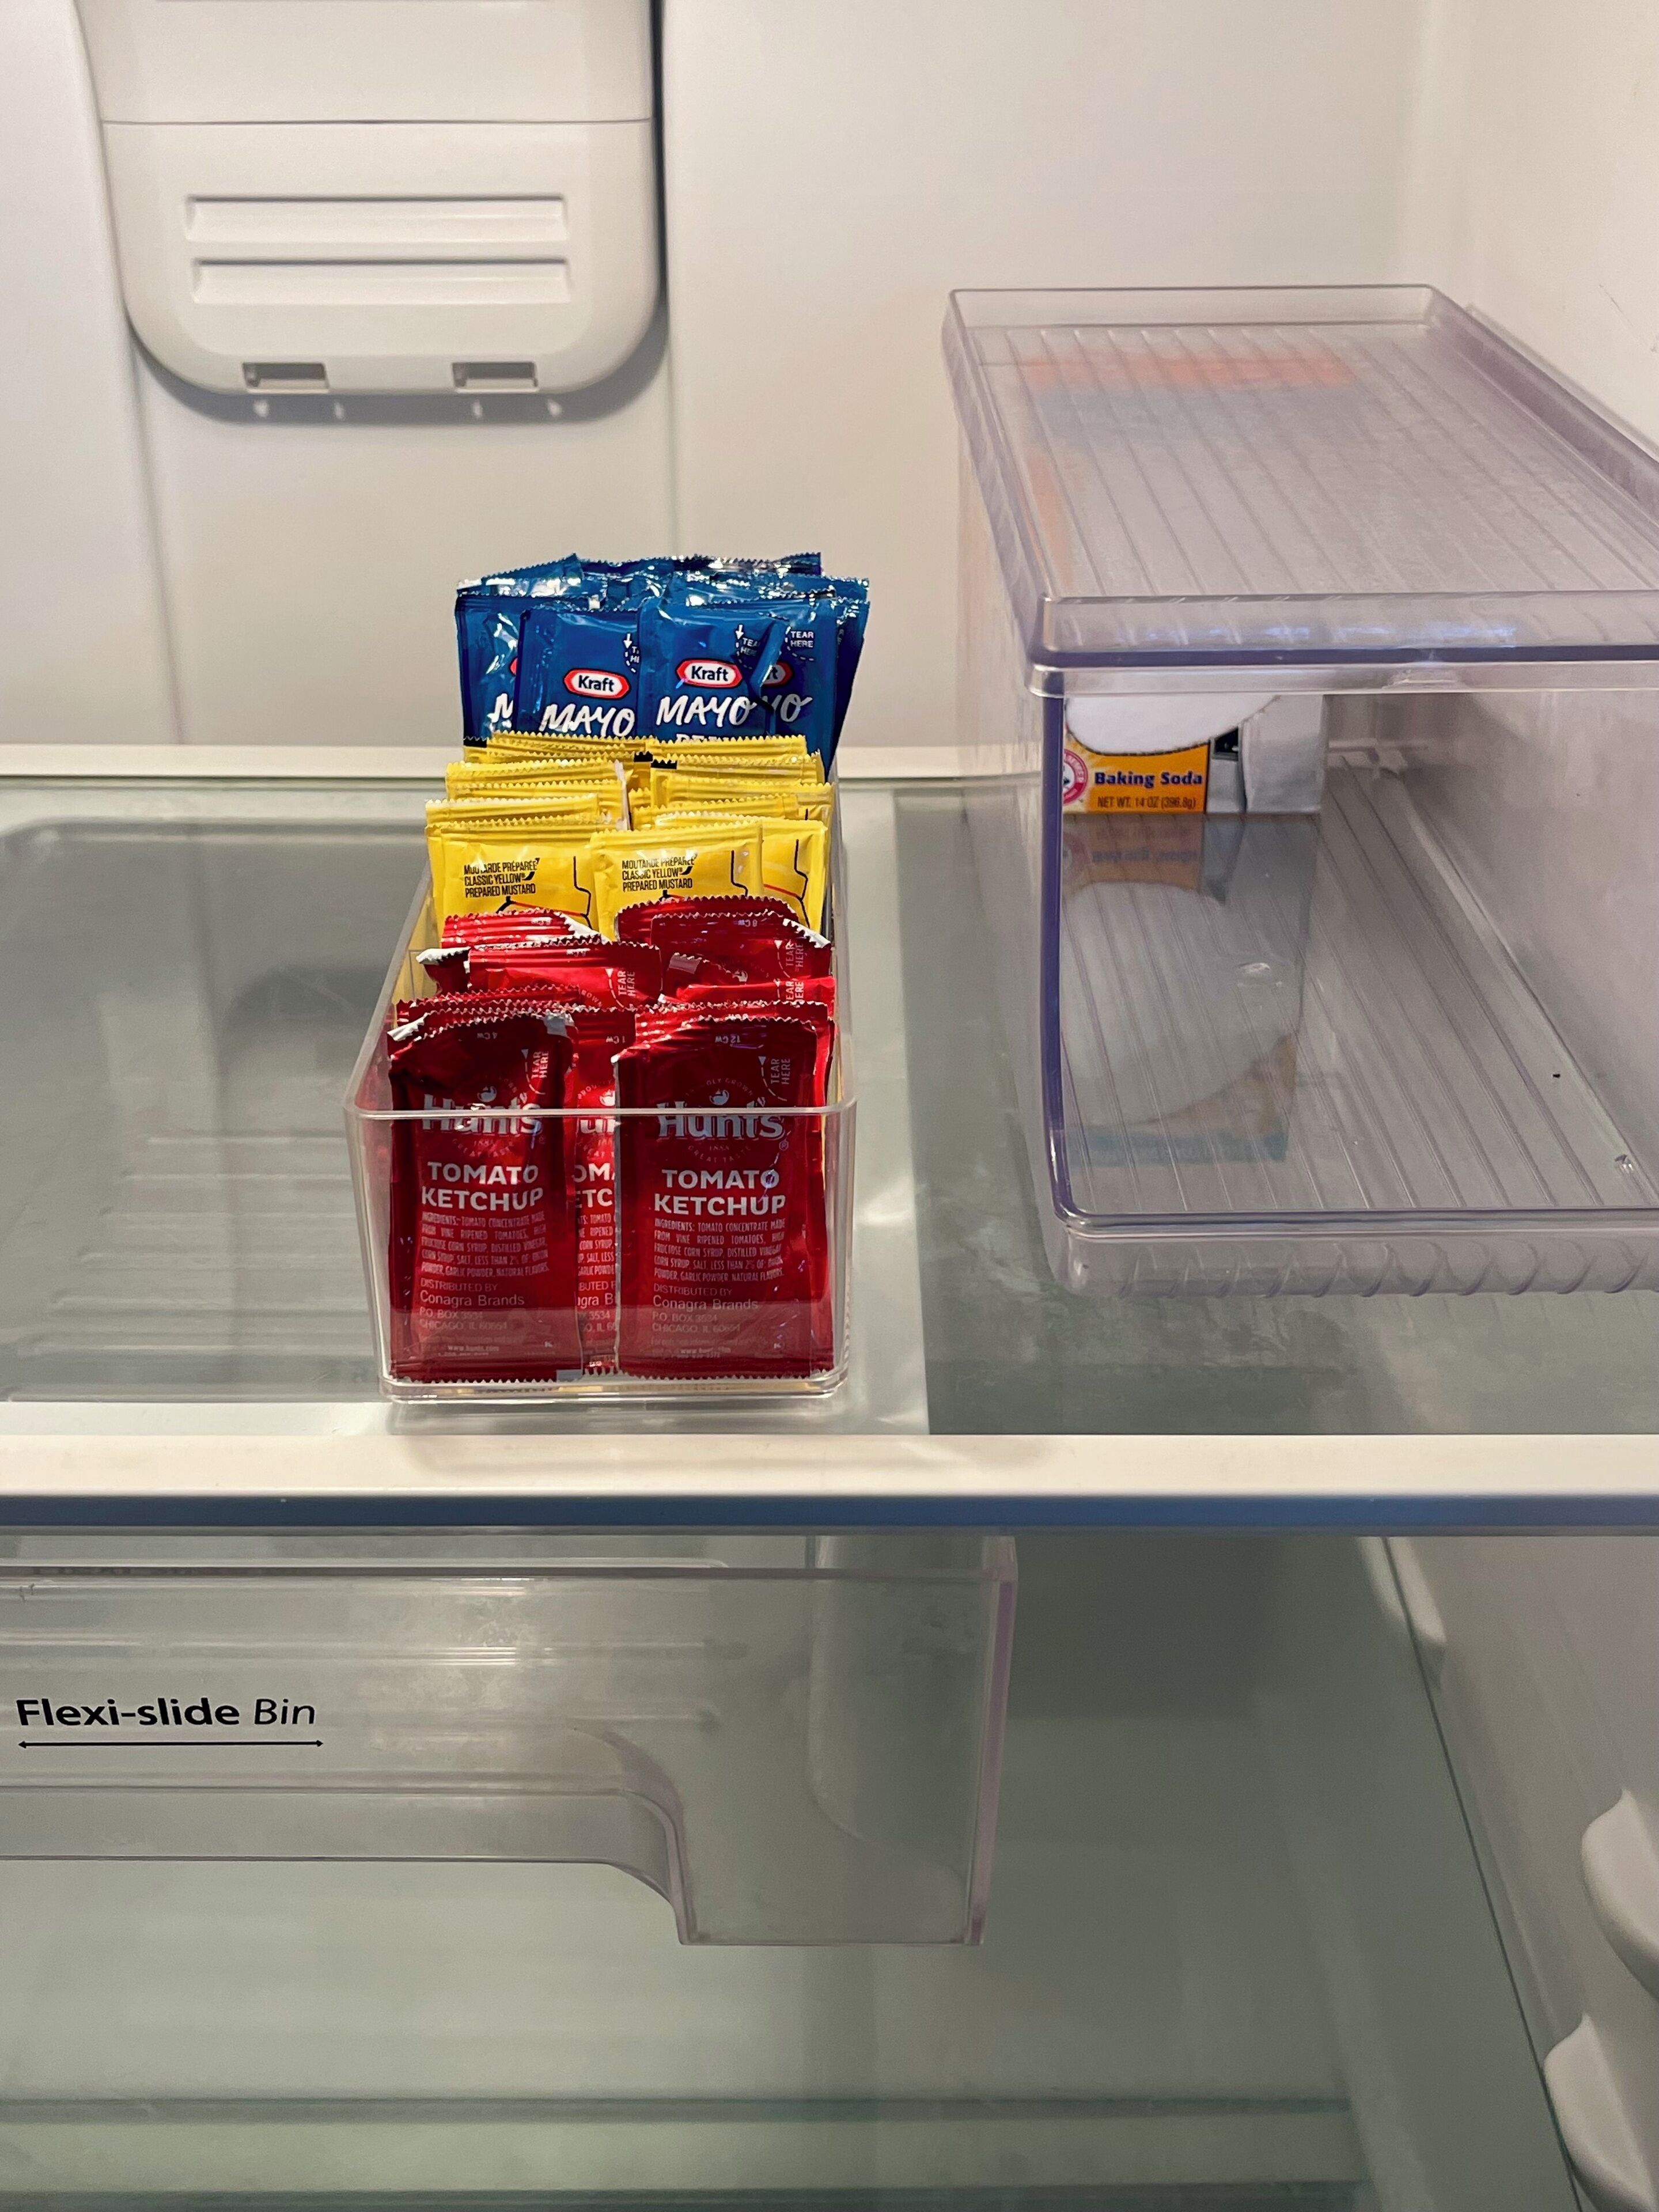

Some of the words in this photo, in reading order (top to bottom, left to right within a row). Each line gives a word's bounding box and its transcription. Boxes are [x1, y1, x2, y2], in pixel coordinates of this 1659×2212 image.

[743, 638, 760, 647] TEA
[790, 639, 814, 648] HERE
[791, 631, 814, 639] TEAR
[740, 646, 757, 656] HER
[691, 665, 729, 682] Kraft
[578, 675, 615, 692] Kraft
[539, 703, 635, 737] MAYO
[656, 695, 757, 728] MAYO
[1095, 771, 1155, 789] Baking
[1161, 771, 1203, 786] Soda
[1097, 796, 1115, 808] NET
[1147, 796, 1160, 808] OZ
[464, 874, 494, 887] CLASSIC
[623, 879, 657, 893] PREPARED
[658, 877, 693, 890] MUSTARD
[465, 885, 501, 899] PREPARED
[501, 882, 536, 896] MUSTARD
[786, 940, 795, 967] TEAR
[795, 942, 805, 968] HERE
[617, 970, 627, 996] TEAR
[626, 971, 636, 997] HERE
[786, 980, 795, 1001] EAR
[531, 1051, 541, 1080] TEAR
[539, 1051, 550, 1079] HERE
[771, 1058, 780, 1084] TEAR
[781, 1058, 790, 1085] HERE
[422, 1094, 543, 1135] Hunt's
[657, 1099, 785, 1139] Hunt's
[427, 1161, 539, 1185] TOMATO
[661, 1169, 779, 1191] TOMATO
[421, 1185, 544, 1212] KETCHUP
[654, 1193, 786, 1216] KETCHUP
[461, 1216, 486, 1228] TOMATO
[590, 1213, 611, 1224] TOMATO
[654, 1218, 695, 1232] INGREDIENTS:
[698, 1222, 723, 1233] TOMATO
[726, 1221, 768, 1232] CONCENTRATE
[461, 1229, 488, 1240] RIPENED
[654, 1230, 671, 1242] FROM
[697, 1235, 725, 1245] RIPENED
[491, 1242, 521, 1252] DISTILLED
[684, 1247, 700, 1257] CORN
[728, 1247, 757, 1257] DISTILLED
[475, 1255, 489, 1266] LESS
[601, 1252, 615, 1262] LESS
[711, 1260, 725, 1270] LESS
[727, 1260, 744, 1270] THAN
[421, 1277, 483, 1292] DISTRIBUTED
[485, 1283, 498, 1292] BY
[680, 1271, 702, 1282] GARLIC
[419, 1289, 472, 1308] Conagra
[478, 1294, 525, 1306] Brands
[653, 1283, 718, 1297] DISTRIBUTED
[720, 1287, 733, 1296] BY
[653, 1294, 707, 1312] Conagra
[712, 1298, 759, 1310] Brands
[437, 1309, 459, 1320] BOX
[672, 1313, 692, 1323] BOX
[16, 1697, 240, 1726] Flexi-slide
[253, 1698, 316, 1726] Bin
